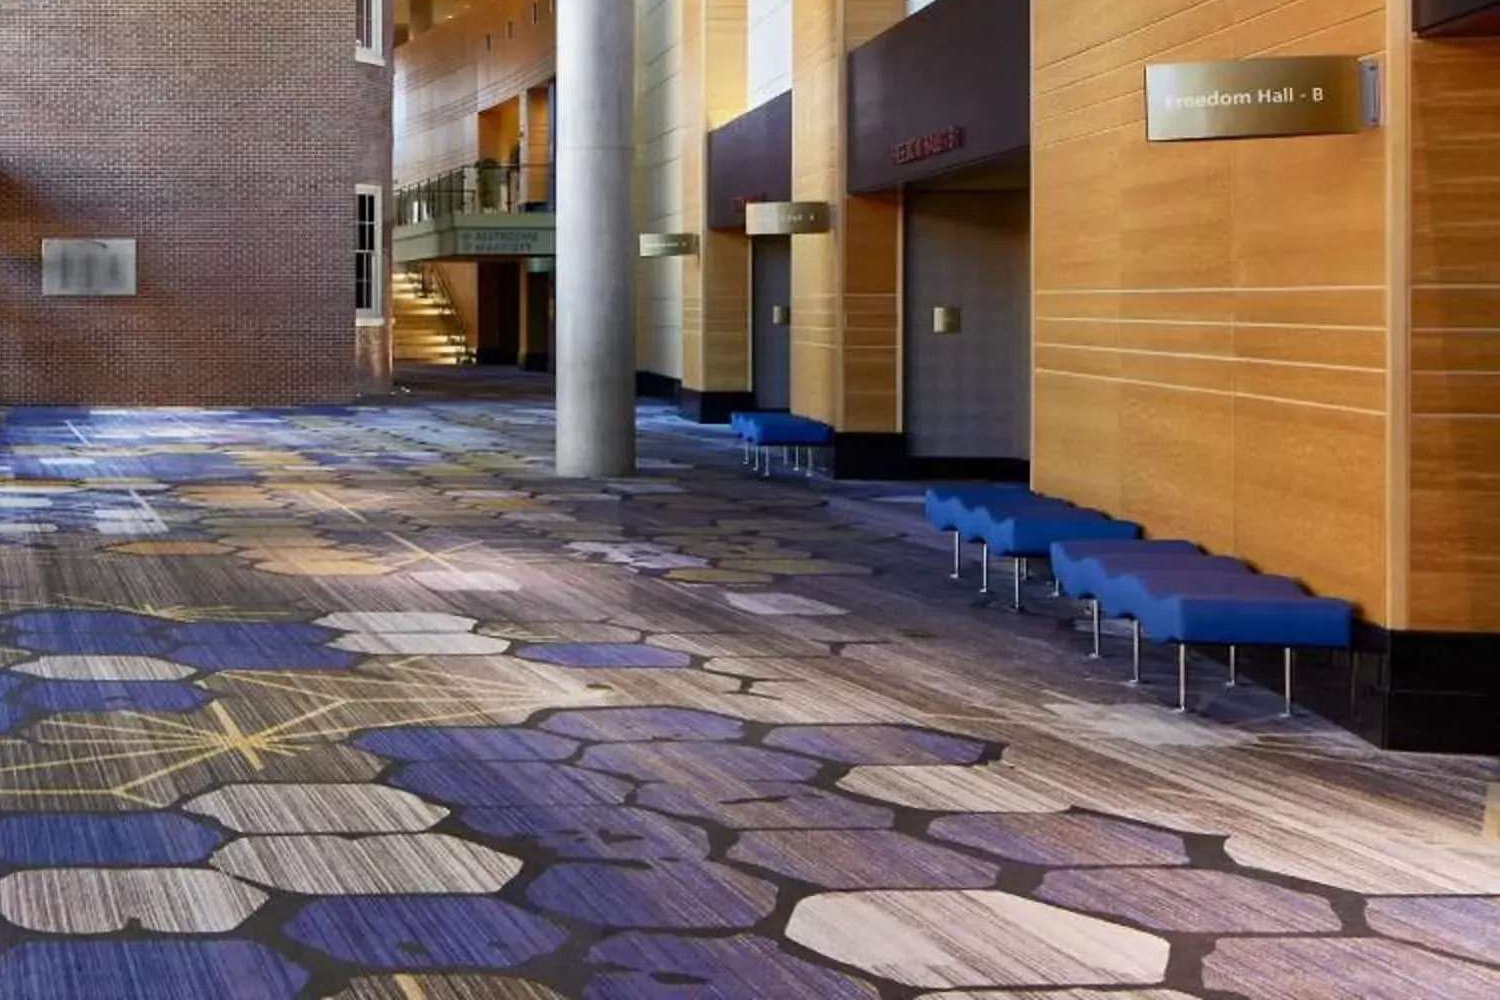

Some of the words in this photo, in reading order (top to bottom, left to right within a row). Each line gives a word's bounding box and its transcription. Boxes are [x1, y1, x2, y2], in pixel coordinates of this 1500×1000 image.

[1163, 88, 1251, 110] Freedom
[1257, 87, 1294, 103] Hall
[1311, 87, 1324, 102] B
